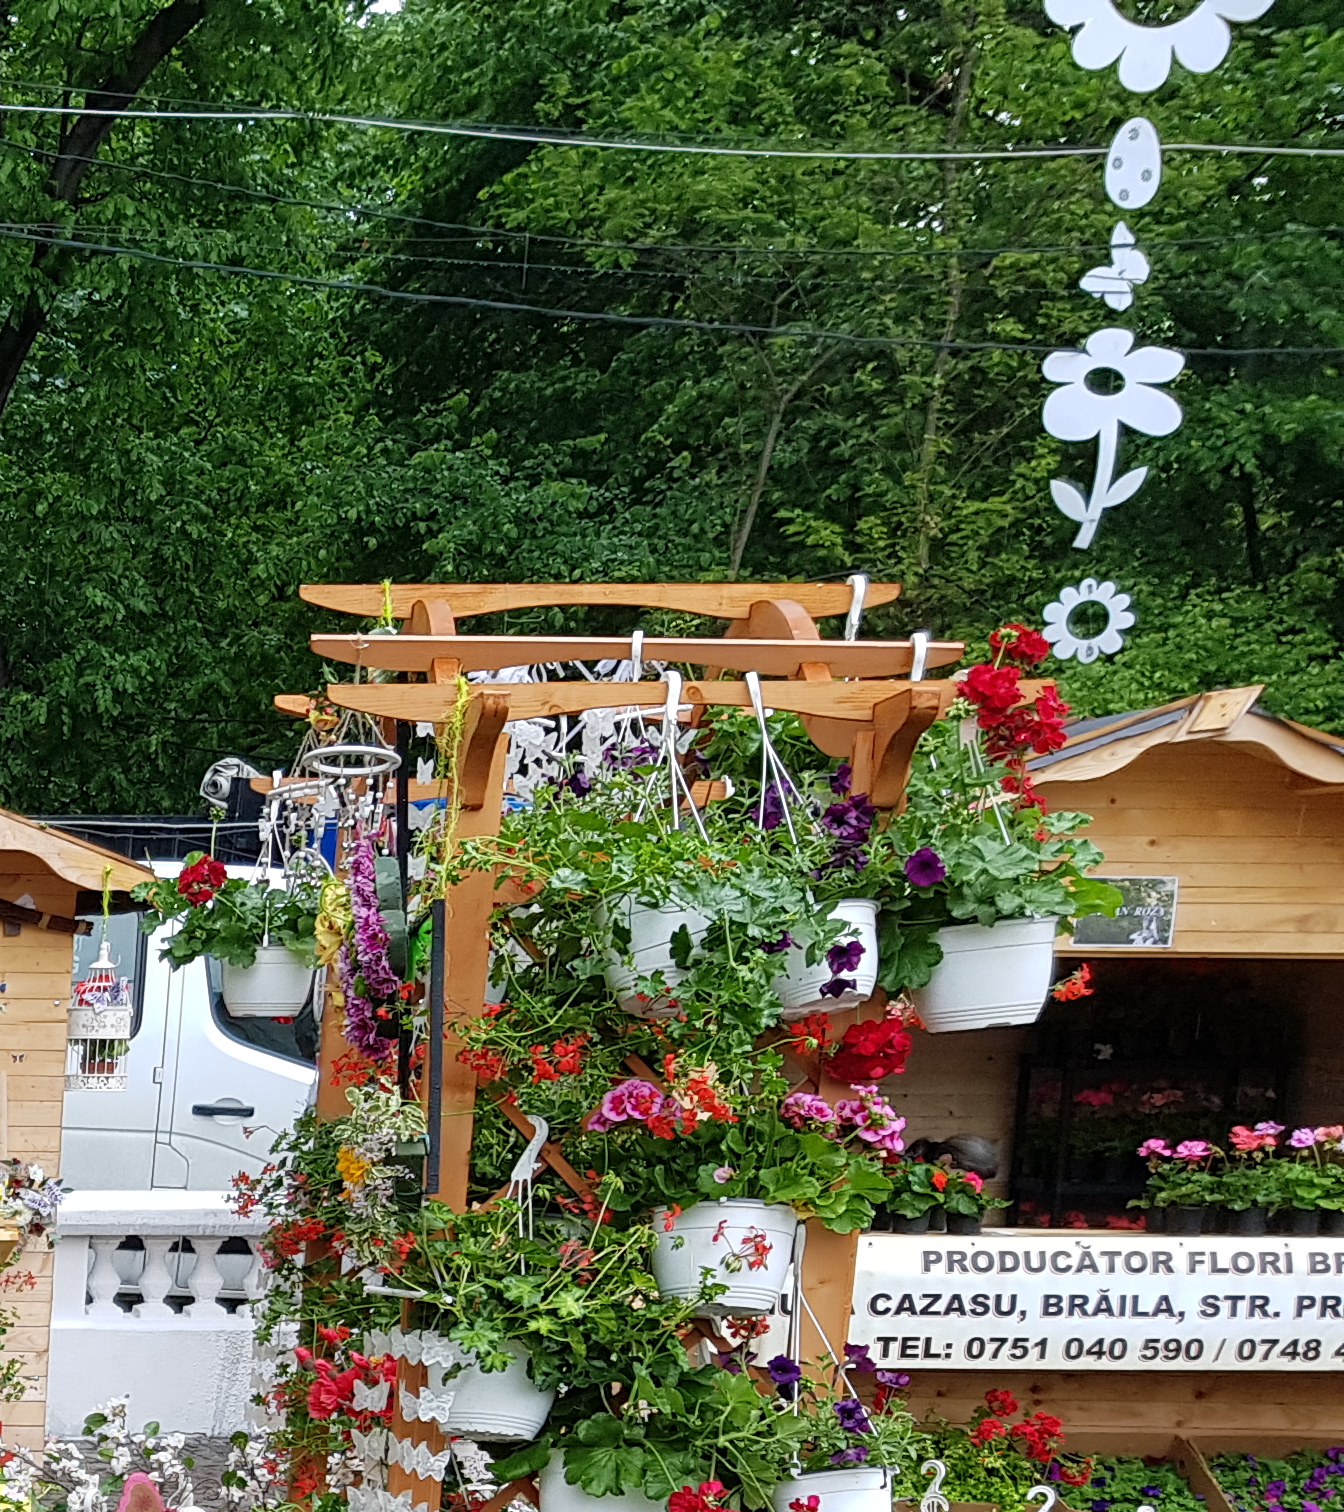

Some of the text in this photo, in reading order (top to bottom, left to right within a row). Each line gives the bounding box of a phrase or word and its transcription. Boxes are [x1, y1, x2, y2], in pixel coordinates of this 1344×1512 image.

[921, 1244, 1175, 1275] PRODUCĂTOR
[1186, 1251, 1293, 1276] FLORI
[867, 1293, 1028, 1323] CAZASU,
[1040, 1288, 1185, 1324] BRĂILA,
[1197, 1294, 1281, 1319] STR.
[874, 1336, 953, 1360] TEL:
[964, 1336, 1048, 1361] 0751
[1063, 1337, 1128, 1362] 040
[1138, 1338, 1205, 1362] 590
[1235, 1338, 1322, 1362] 0748
